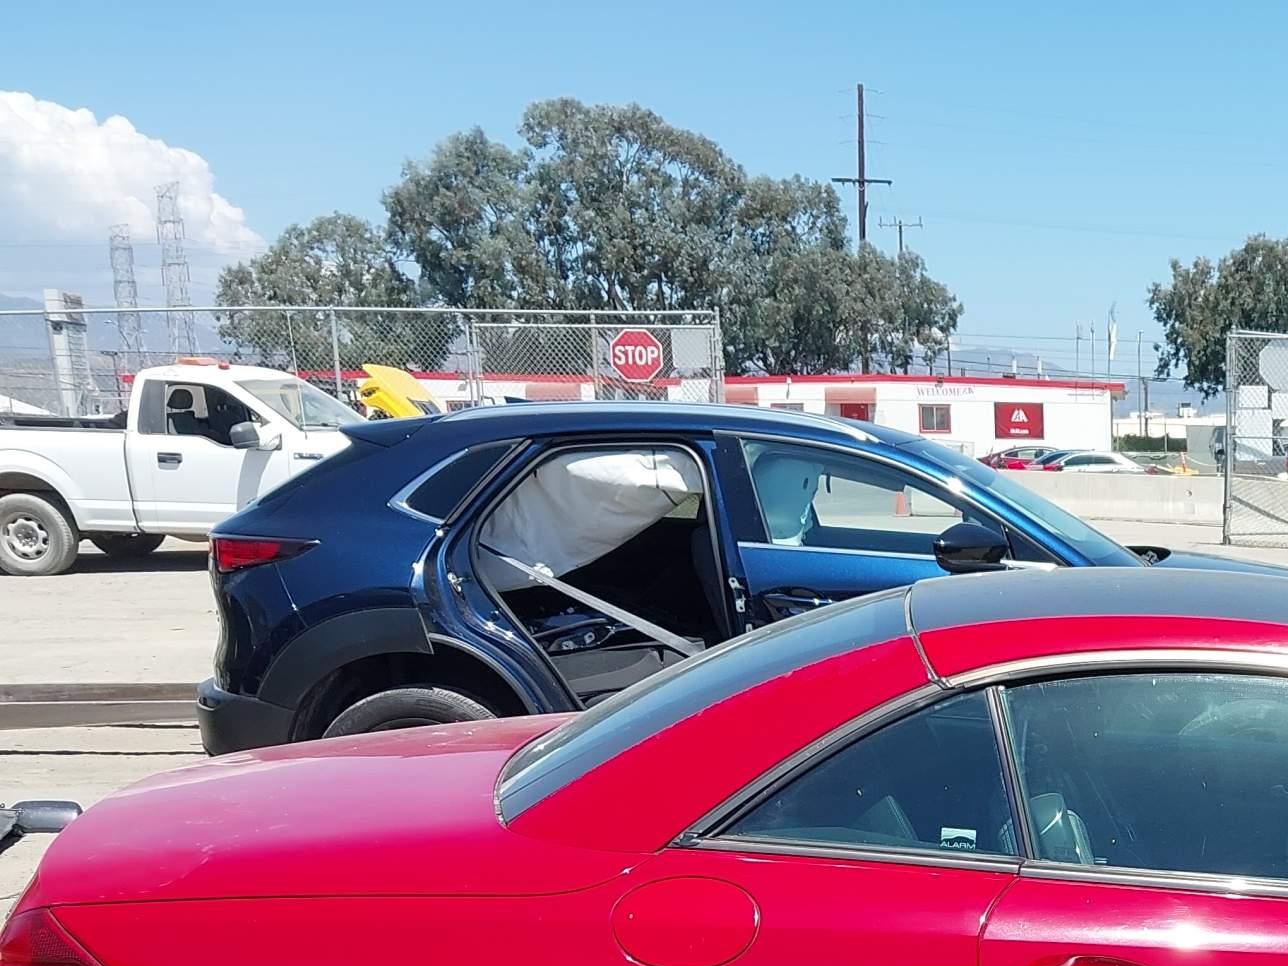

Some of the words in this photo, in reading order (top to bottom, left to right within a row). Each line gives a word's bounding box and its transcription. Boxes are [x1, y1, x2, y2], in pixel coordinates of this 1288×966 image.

[614, 345, 659, 366] STOP
[916, 386, 960, 397] WELCOME
[940, 841, 976, 850] ALARM
